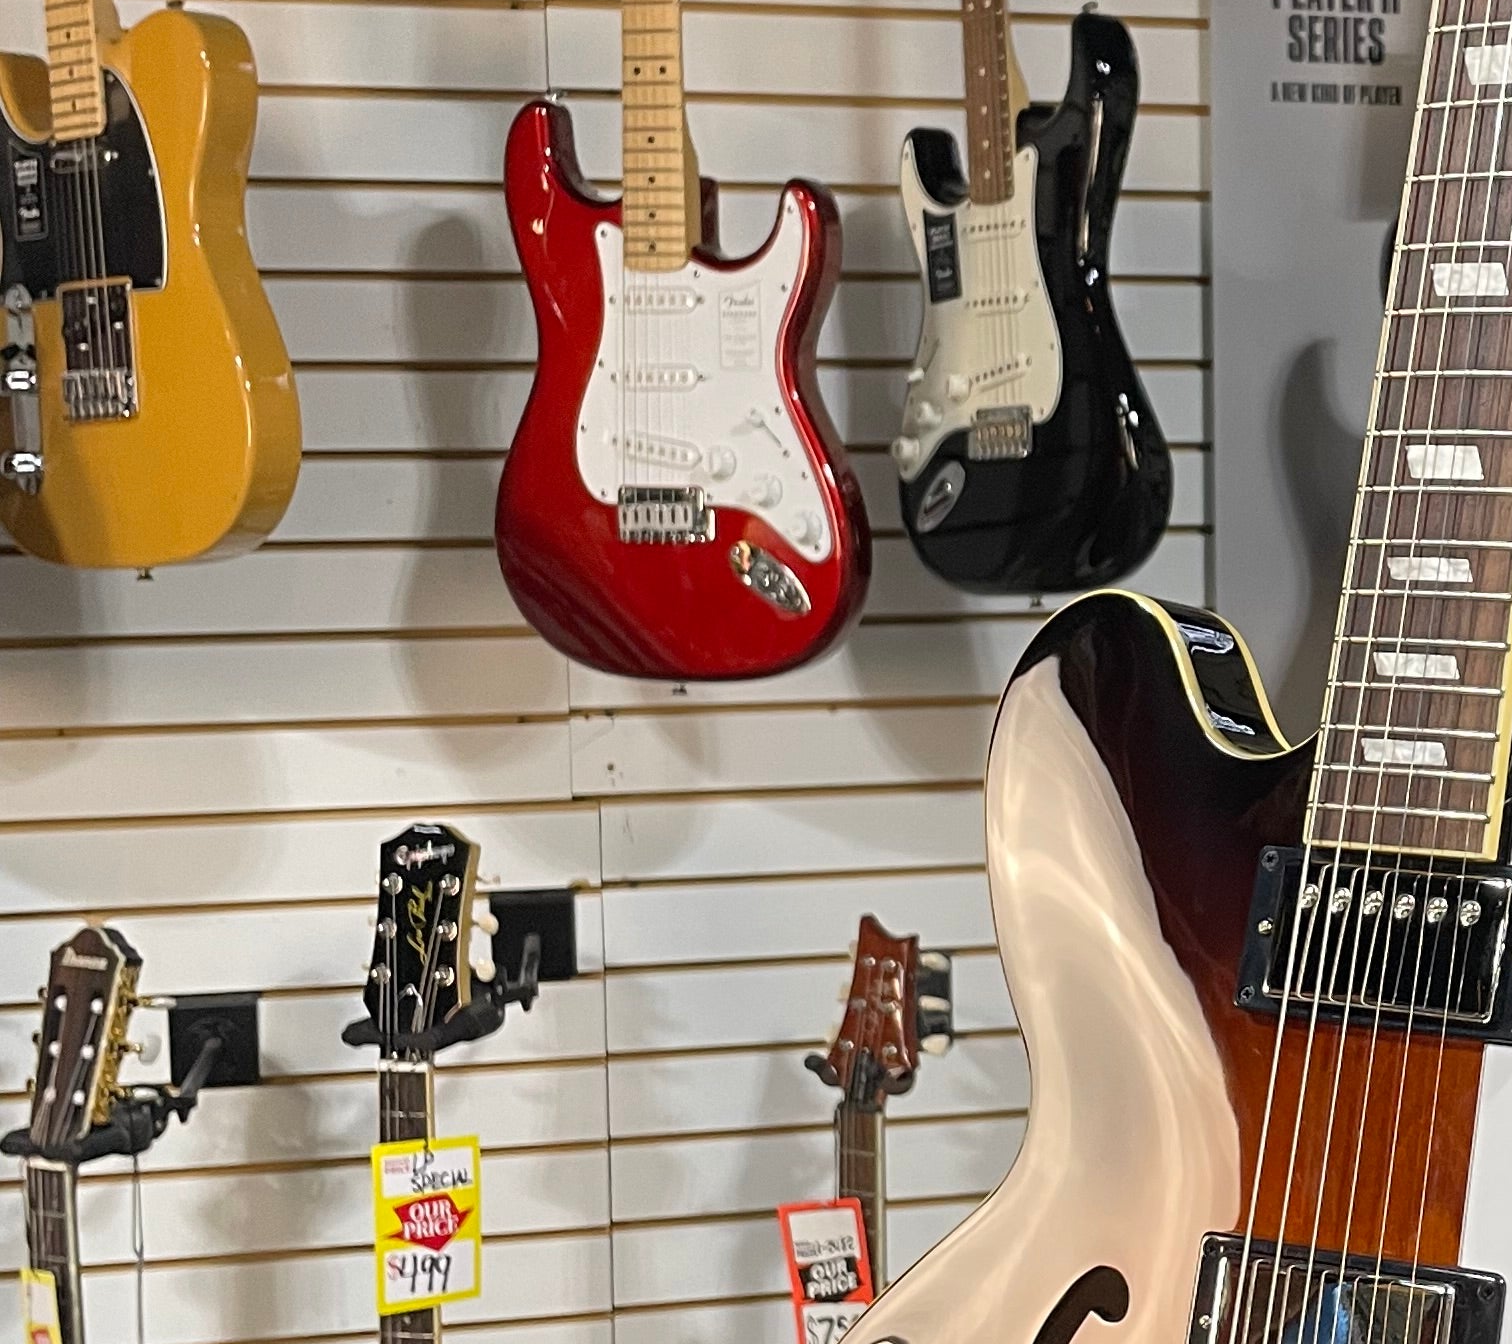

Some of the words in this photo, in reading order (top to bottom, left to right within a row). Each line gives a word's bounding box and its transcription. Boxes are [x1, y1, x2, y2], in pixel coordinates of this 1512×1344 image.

[1287, 14, 1386, 65] SERIES
[409, 1199, 452, 1223] OUR
[403, 1214, 460, 1241] PRICE
[387, 1254, 452, 1294] $499
[809, 1258, 848, 1282] OUR
[806, 1273, 859, 1300] PRICE
